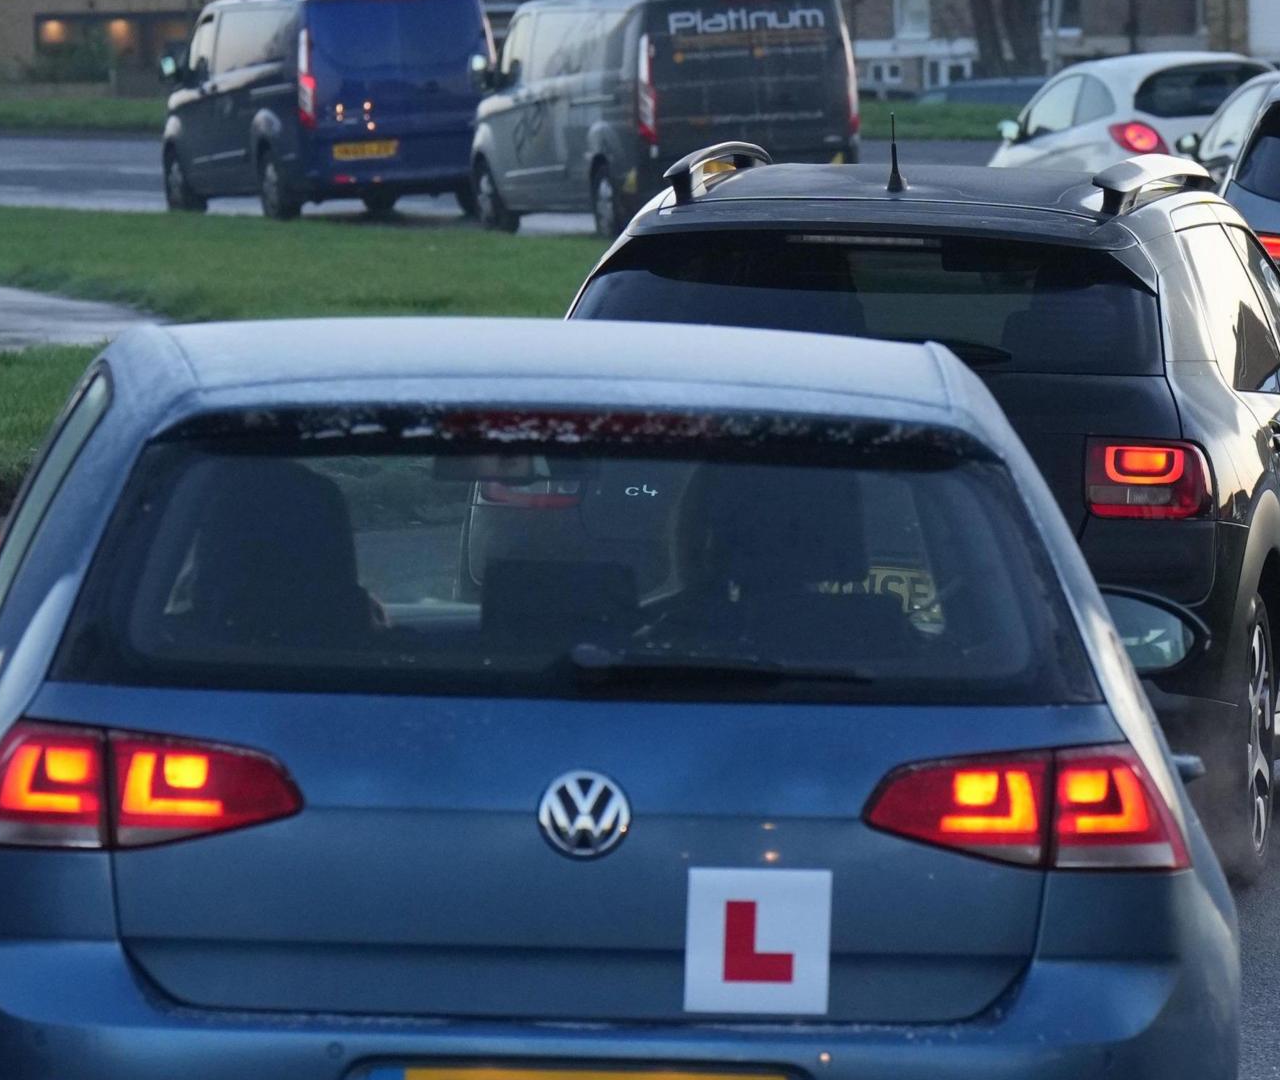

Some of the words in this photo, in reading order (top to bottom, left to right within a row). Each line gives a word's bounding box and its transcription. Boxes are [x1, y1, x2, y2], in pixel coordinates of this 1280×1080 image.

[668, 8, 825, 35] Platinum
[625, 484, 658, 497] C4
[723, 900, 793, 983] L
